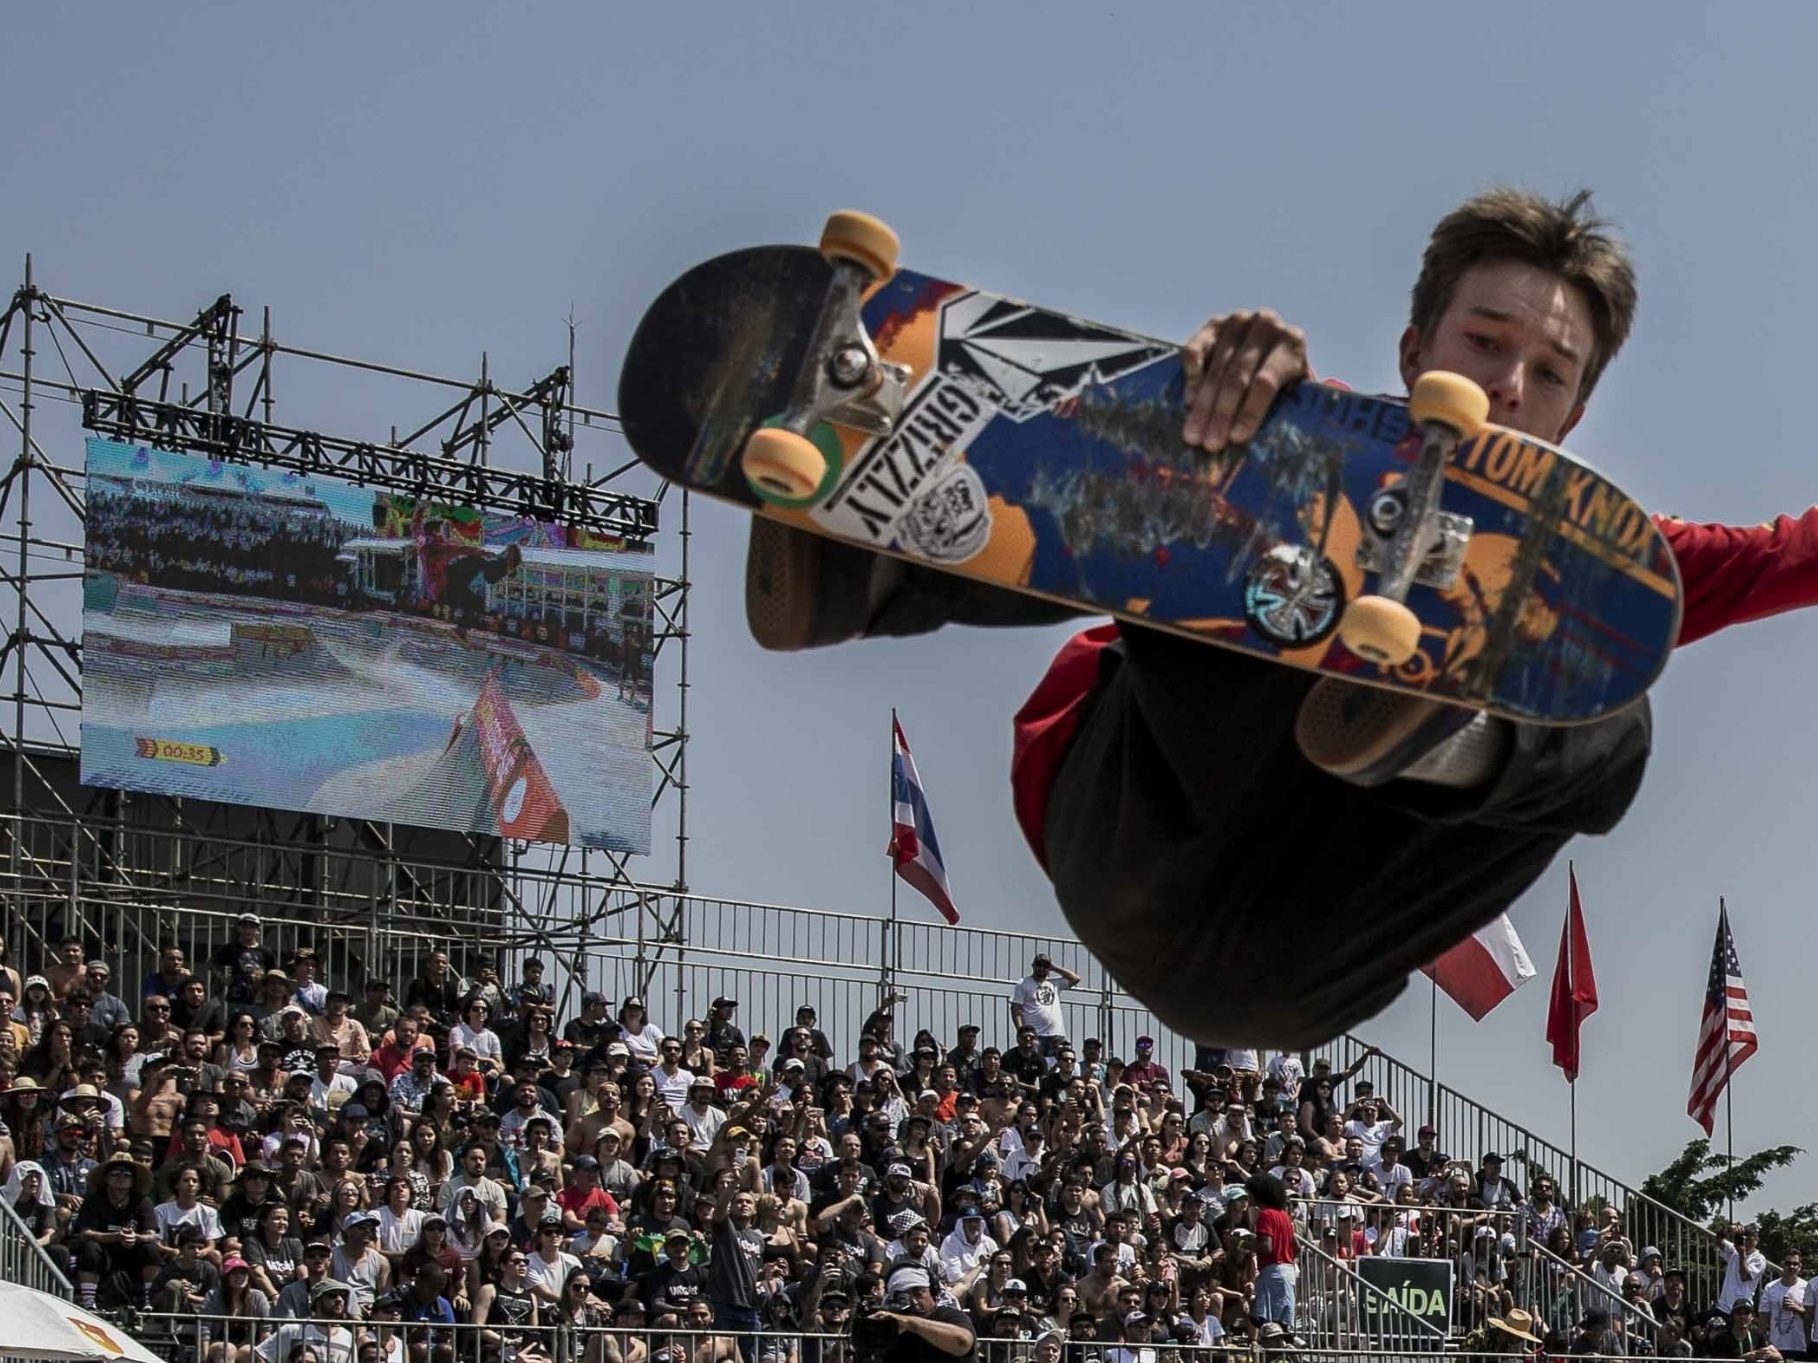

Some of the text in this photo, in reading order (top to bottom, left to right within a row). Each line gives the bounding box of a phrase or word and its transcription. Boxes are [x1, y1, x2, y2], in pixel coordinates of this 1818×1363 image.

[846, 385, 980, 538] GRIZZLY
[1465, 428, 1556, 500] TOM
[161, 744, 206, 762] 00:35
